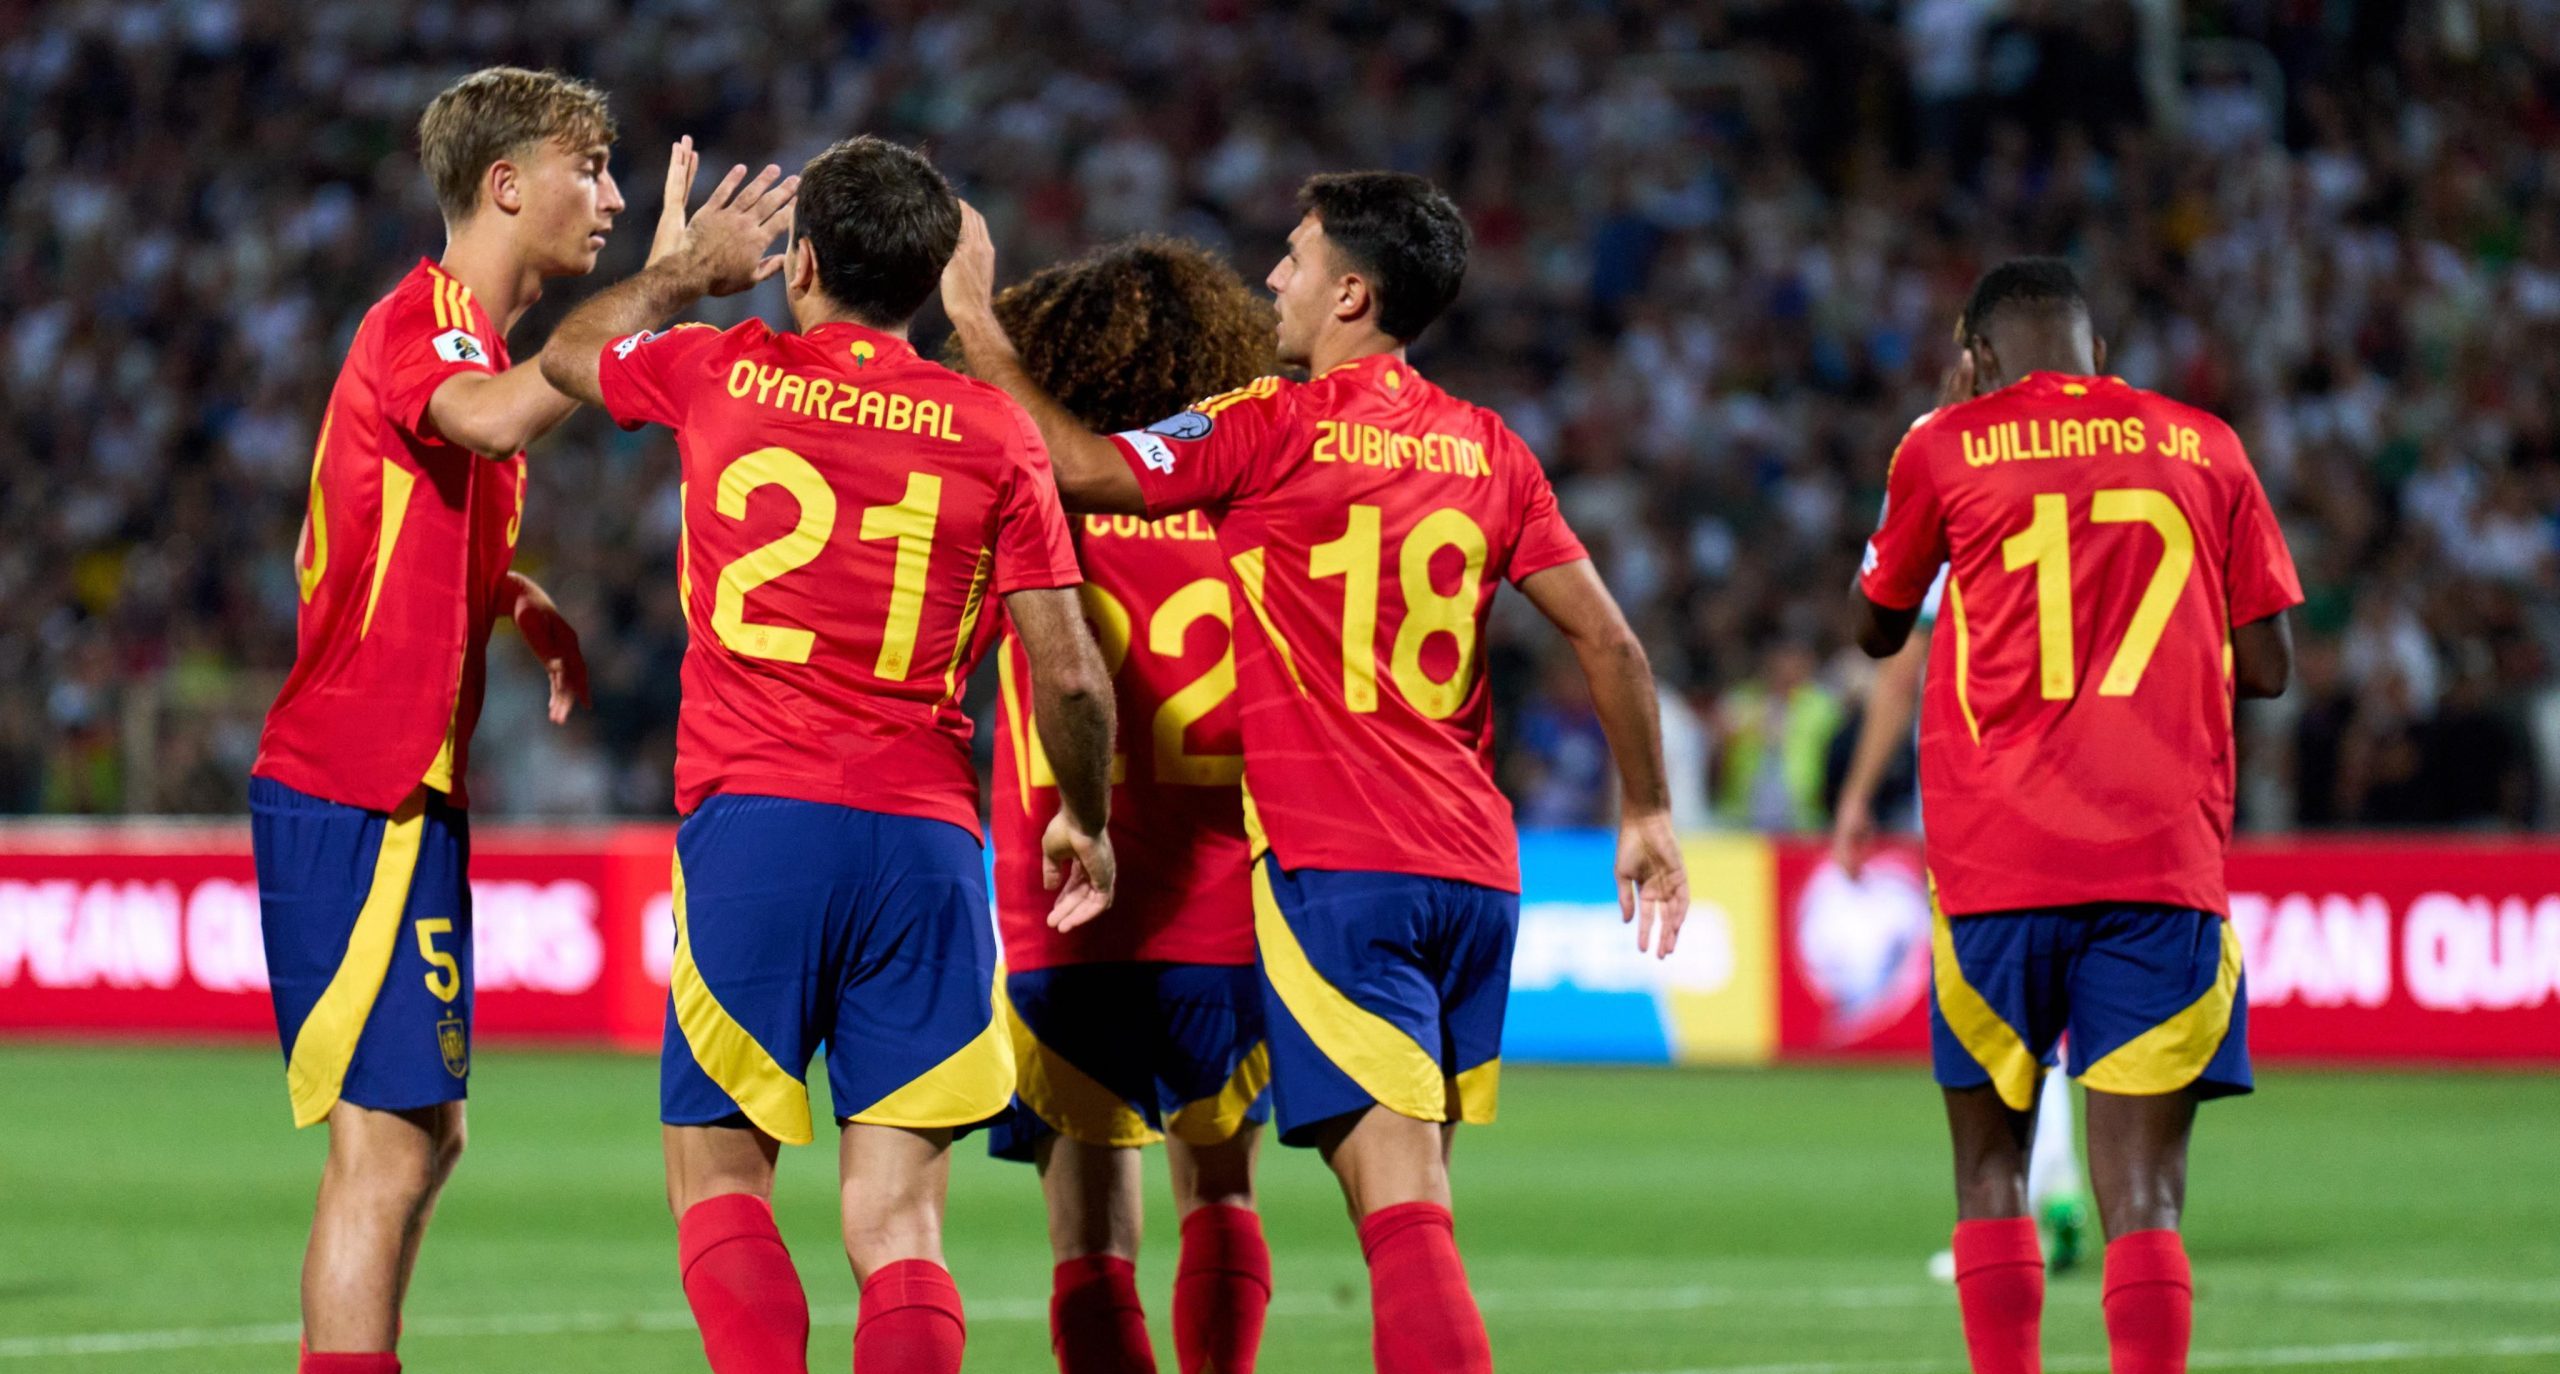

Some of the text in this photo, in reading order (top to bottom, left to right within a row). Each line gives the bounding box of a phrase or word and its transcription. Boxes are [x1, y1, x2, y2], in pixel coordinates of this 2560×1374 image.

[728, 360, 962, 442] OYARZABAL
[1962, 417, 2211, 467] WILLIAMS JR.
[1313, 420, 1492, 479] ZUBIMENDI
[711, 447, 941, 682] 21
[2002, 489, 2195, 700] 17
[1308, 504, 1488, 720] 18
[415, 917, 461, 1003] 5
